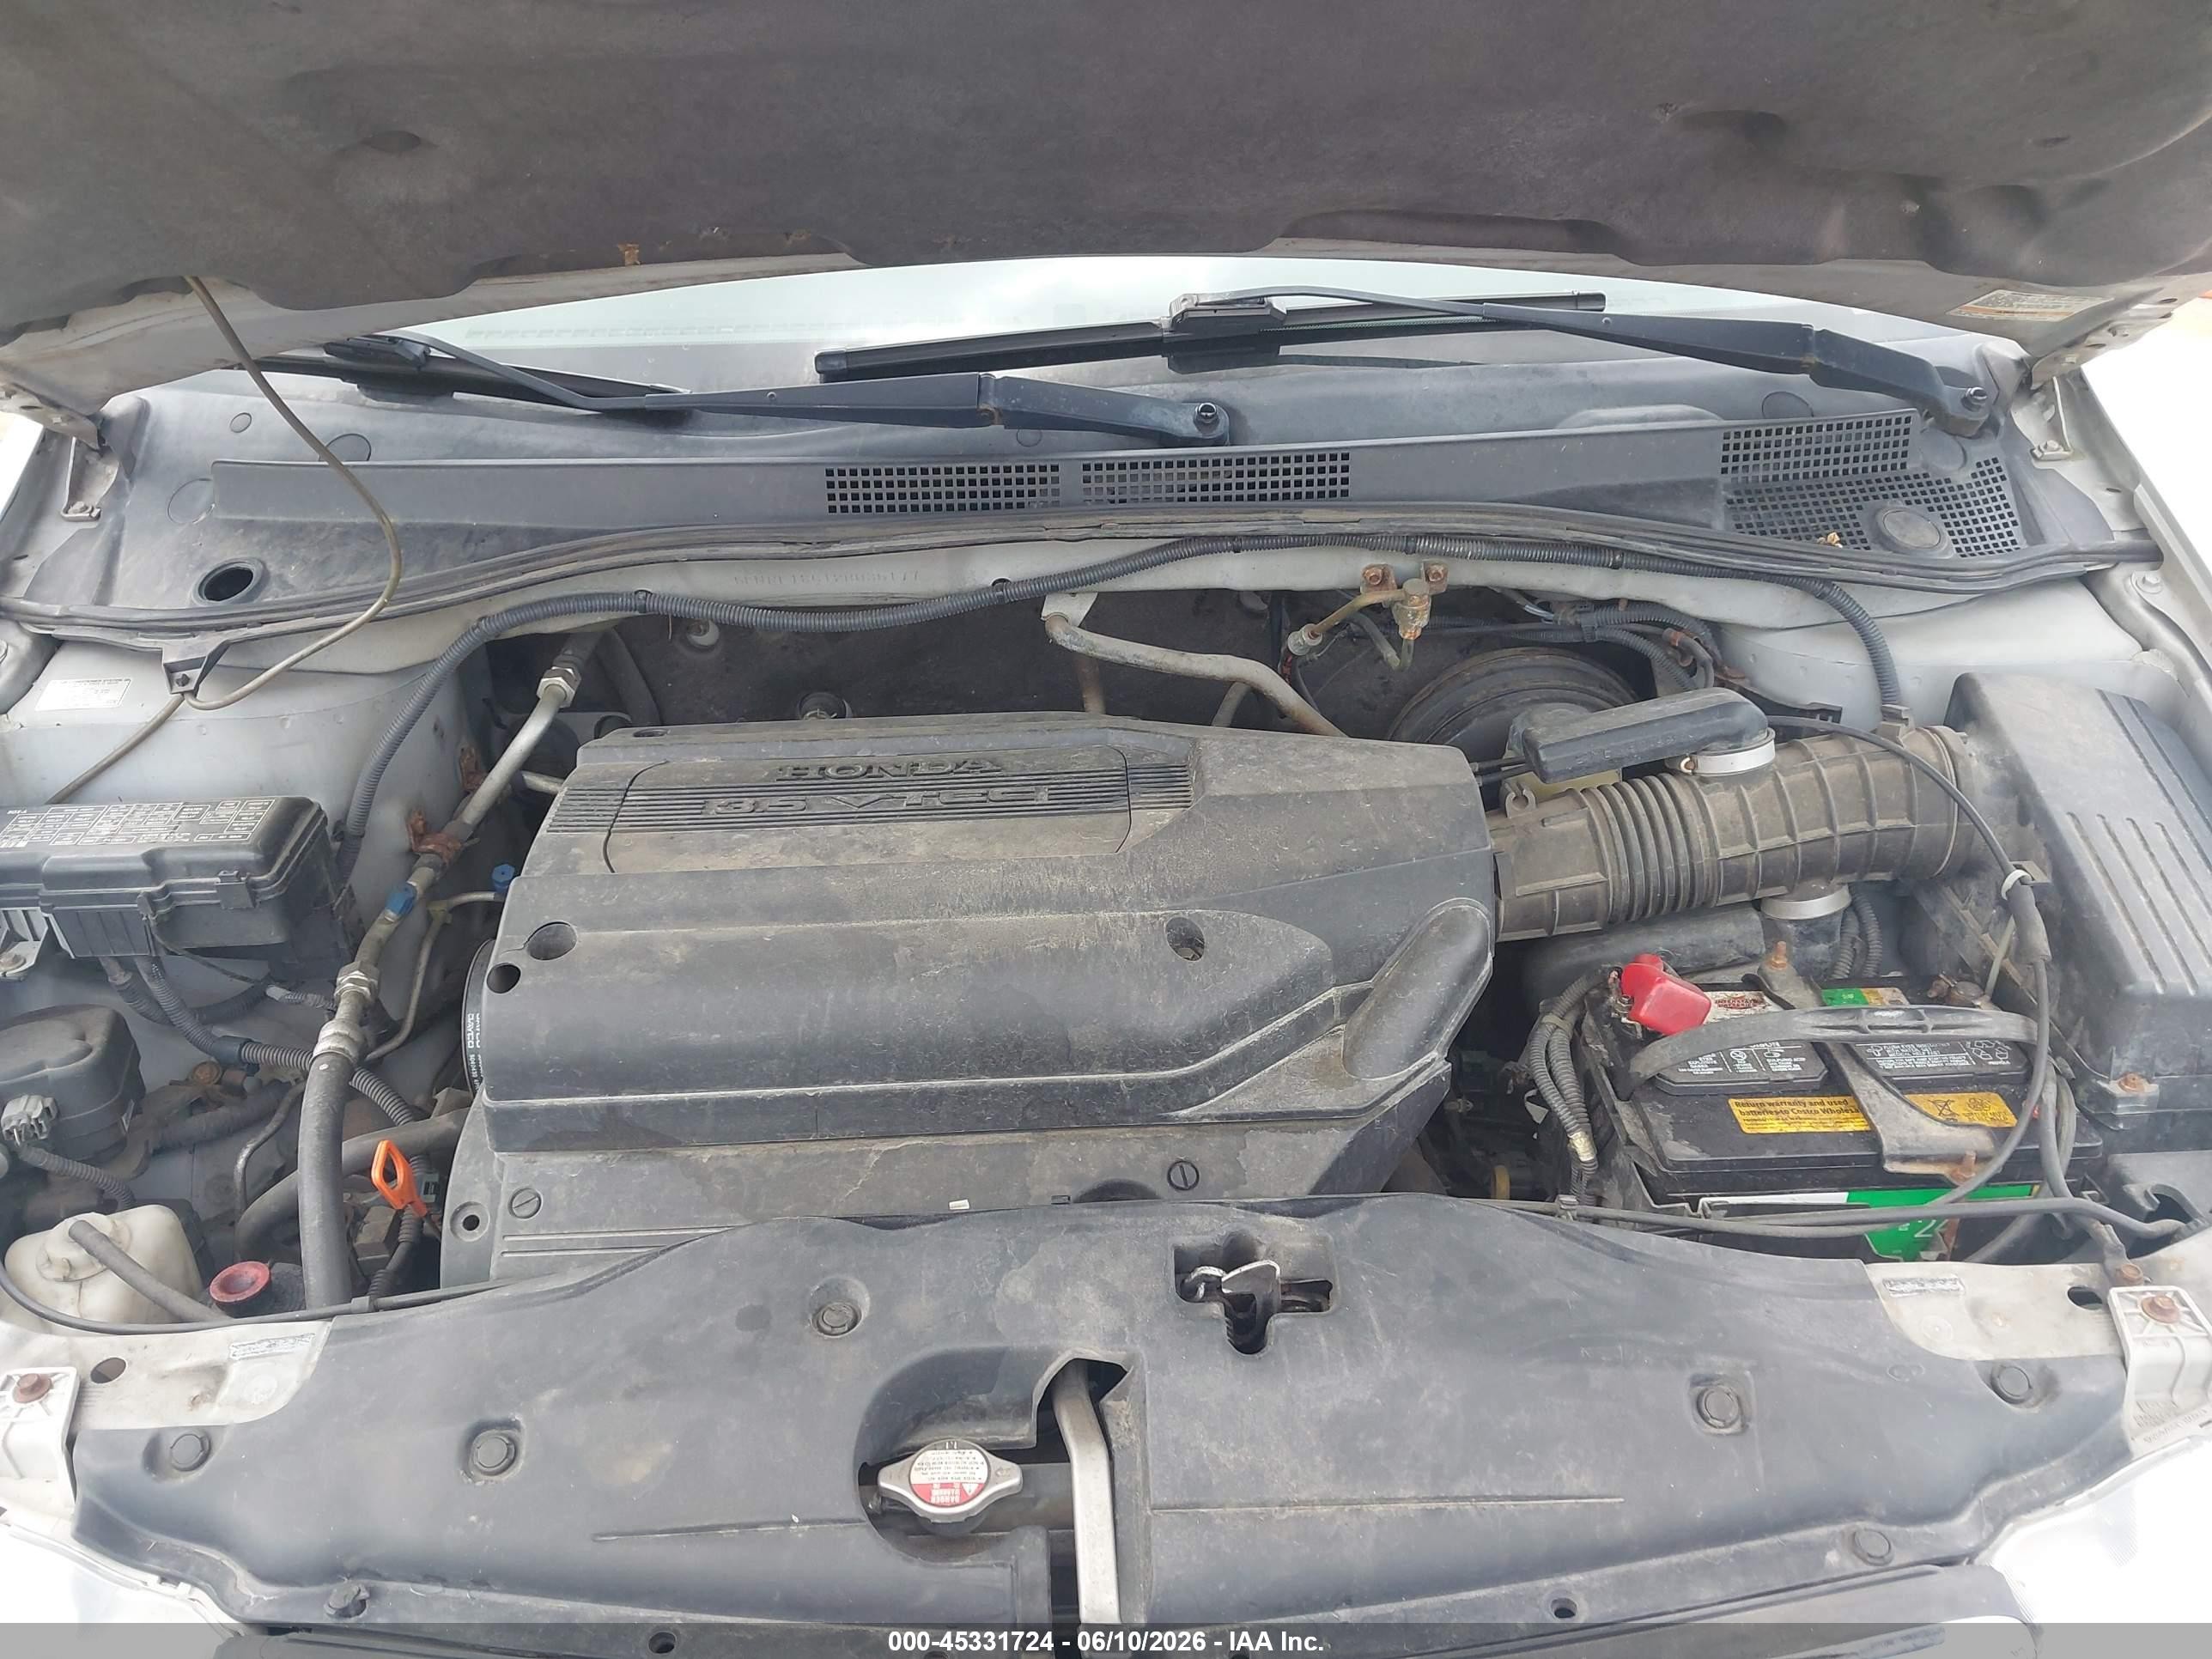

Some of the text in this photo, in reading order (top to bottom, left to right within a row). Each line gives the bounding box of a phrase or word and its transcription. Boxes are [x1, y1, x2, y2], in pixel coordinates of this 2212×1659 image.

[776, 759, 1004, 781] HONDA
[714, 787, 1036, 814] 3.5 VTEC
[1735, 1100, 1765, 1109] Return
[1767, 1100, 1807, 1109] warranty
[1740, 1108, 1778, 1116] batteries
[1791, 1107, 1820, 1115] Costco
[1821, 1106, 1860, 1115] Wholesa
